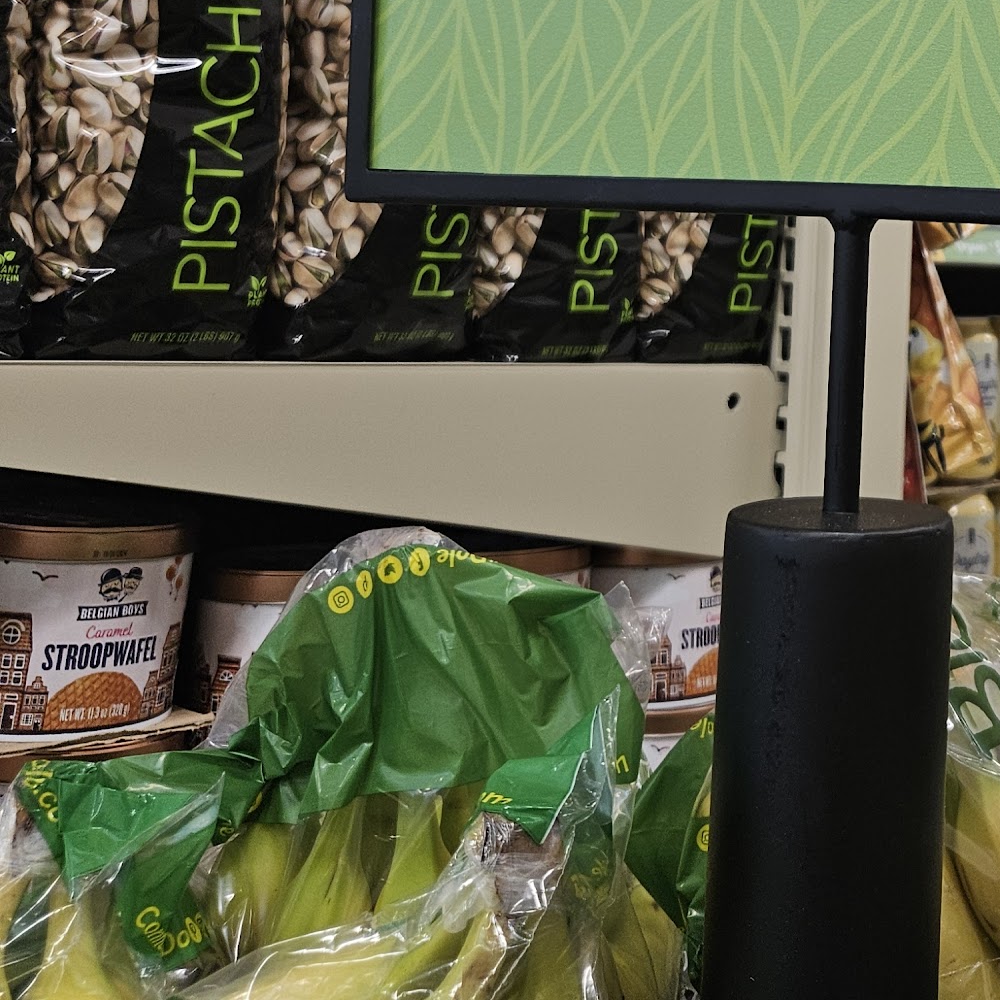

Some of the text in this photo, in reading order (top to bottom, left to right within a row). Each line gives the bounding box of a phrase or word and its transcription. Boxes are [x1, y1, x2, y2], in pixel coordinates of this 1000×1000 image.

[80, 603, 145, 619] BELGIAN BOYS
[85, 621, 135, 640] Caramel
[41, 635, 158, 671] STROOPWAFEL
